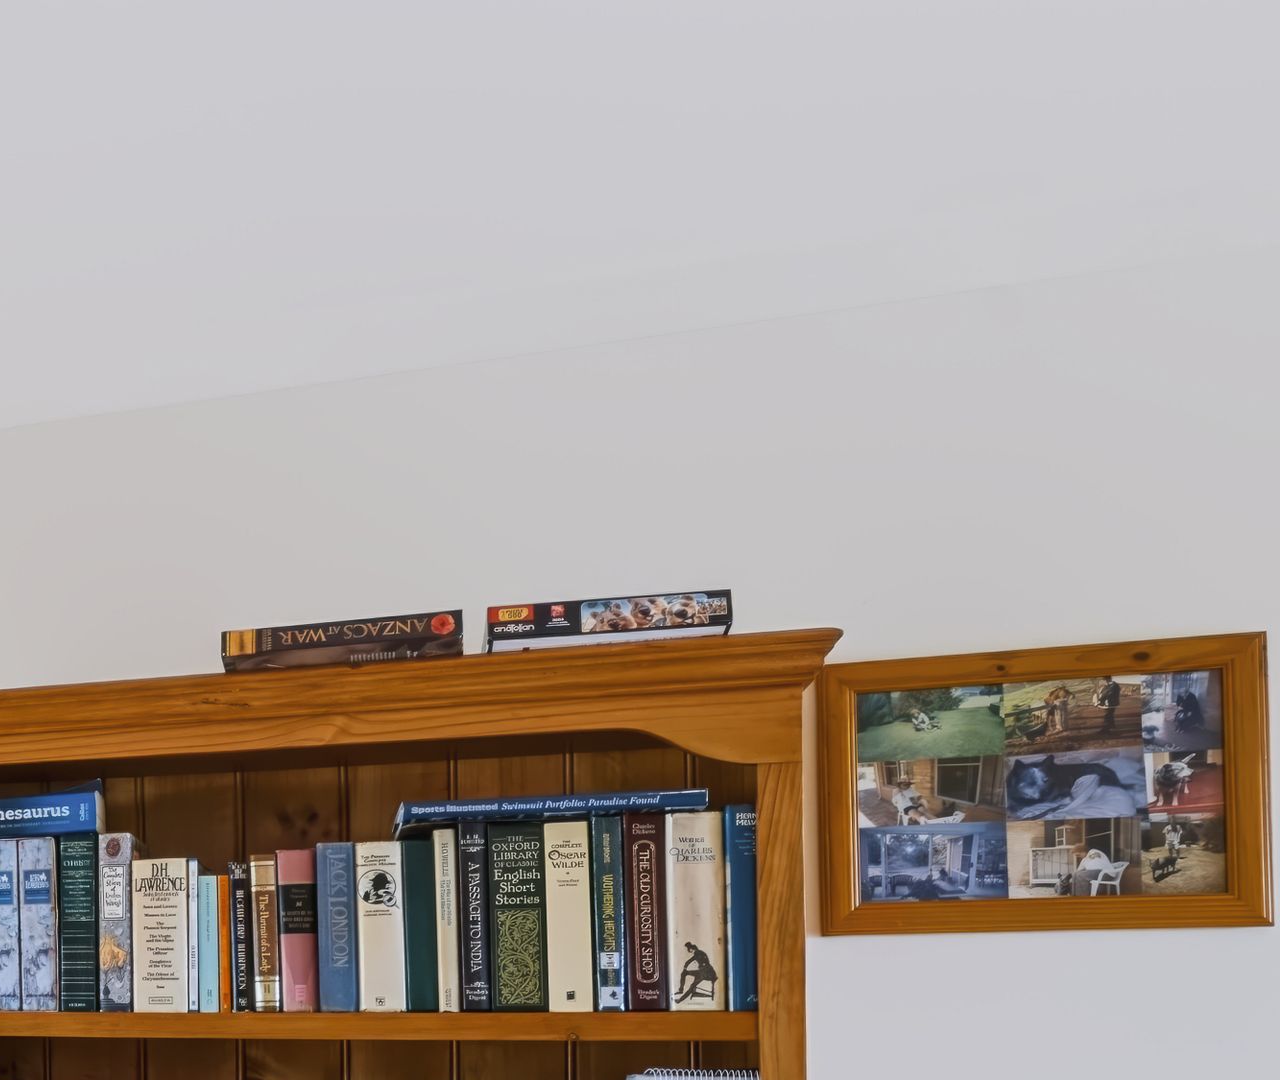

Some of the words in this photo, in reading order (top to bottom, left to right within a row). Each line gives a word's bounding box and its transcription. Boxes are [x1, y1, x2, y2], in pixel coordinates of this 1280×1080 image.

[280, 628, 326, 645] WAR
[328, 626, 340, 634] AT
[344, 618, 428, 639] ANZACS
[411, 806, 445, 814] Sports
[447, 804, 498, 812] Illustrated
[501, 801, 543, 810] Swimsuit
[589, 797, 627, 807] Paradise
[629, 795, 659, 805] Found
[492, 841, 540, 850] OXFORD
[494, 850, 539, 860] LIBRARY
[548, 849, 586, 860] OSCAR
[639, 850, 649, 871] THE
[152, 863, 169, 878] D.H.
[327, 850, 340, 894] JACK
[552, 860, 584, 868] WILDE
[494, 869, 540, 880] English
[135, 877, 186, 893] LAWRENCE
[500, 882, 535, 892] Short
[469, 872, 480, 915] PASSAGE
[496, 893, 540, 905] Stories
[331, 898, 348, 968] LONDON
[471, 934, 482, 972] INDIA
[642, 948, 653, 974] SHOP
